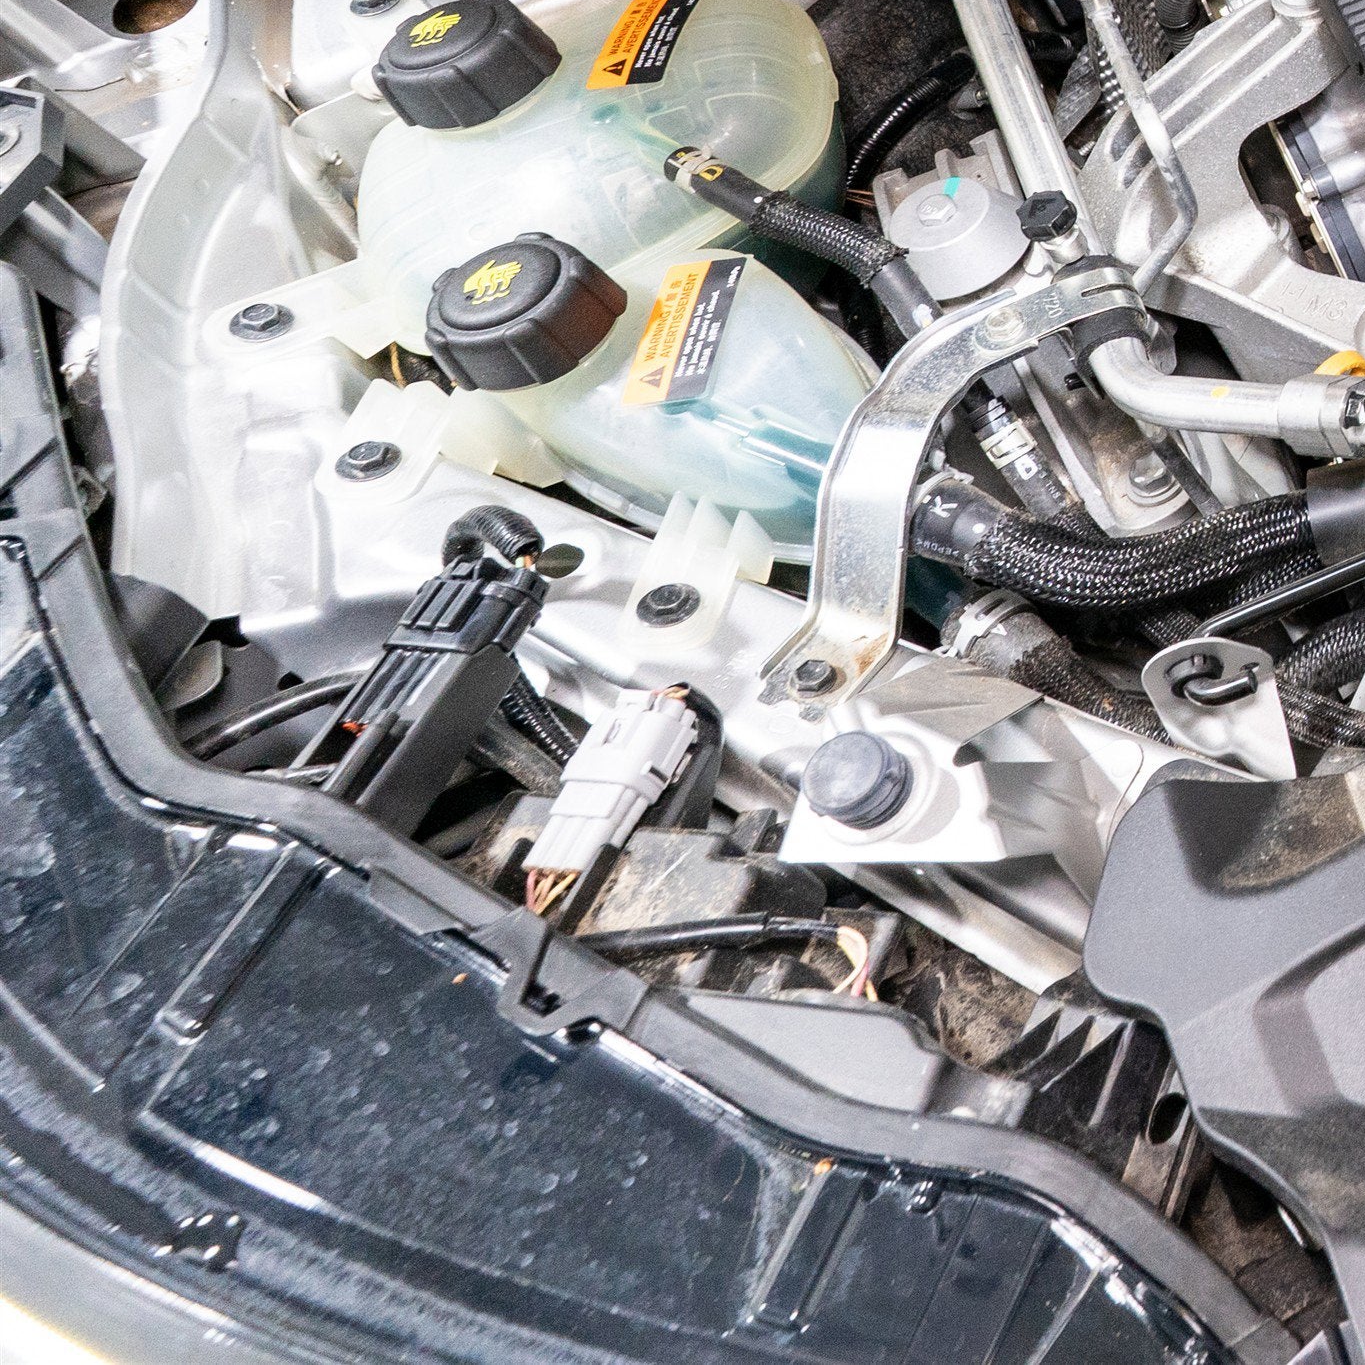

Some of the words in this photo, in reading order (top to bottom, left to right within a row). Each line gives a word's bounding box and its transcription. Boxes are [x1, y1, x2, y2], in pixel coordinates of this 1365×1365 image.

[609, 20, 635, 54] WARNING
[643, 311, 671, 362] WARNING
[660, 274, 699, 357] AVERTISSEMENT
